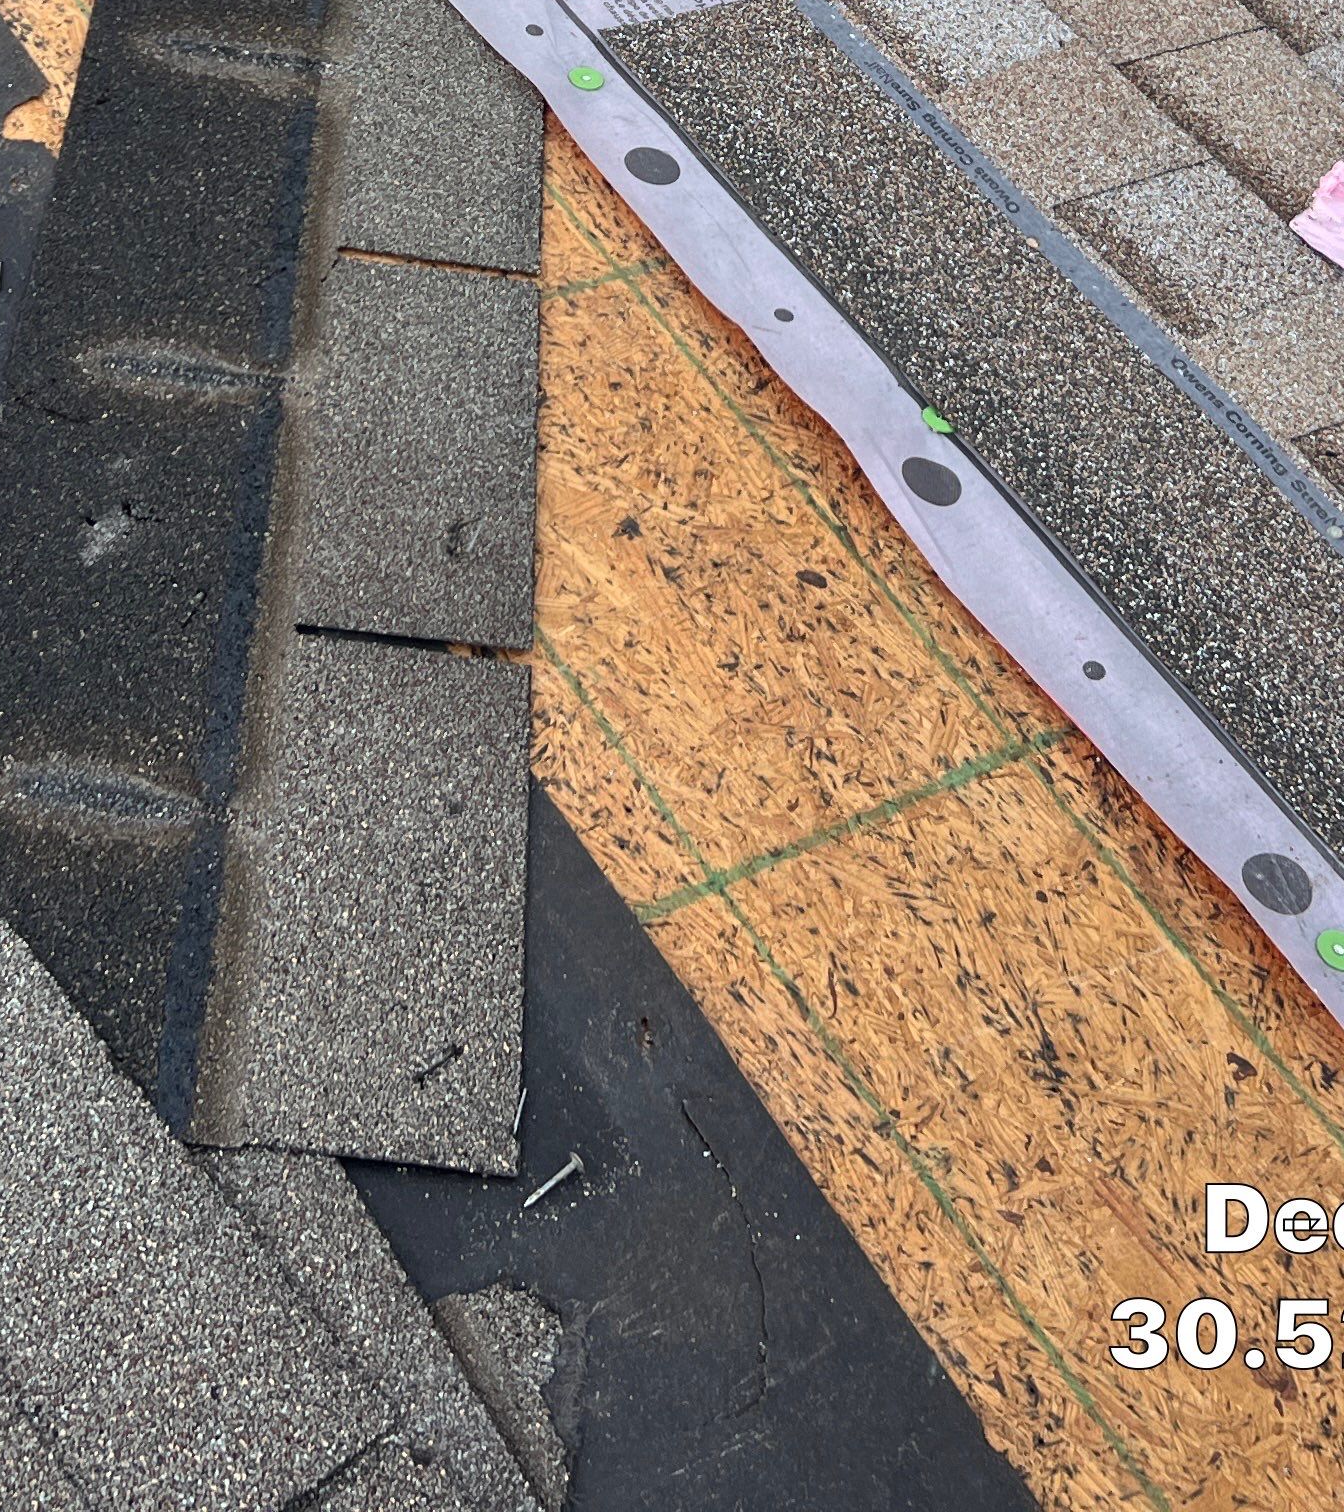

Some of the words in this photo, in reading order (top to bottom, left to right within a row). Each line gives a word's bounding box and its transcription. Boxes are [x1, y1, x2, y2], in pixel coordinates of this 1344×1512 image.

[863, 59, 921, 112] SureNail
[922, 112, 974, 166] Corning
[1169, 355, 1224, 412] Owens
[1224, 408, 1288, 478] Corning
